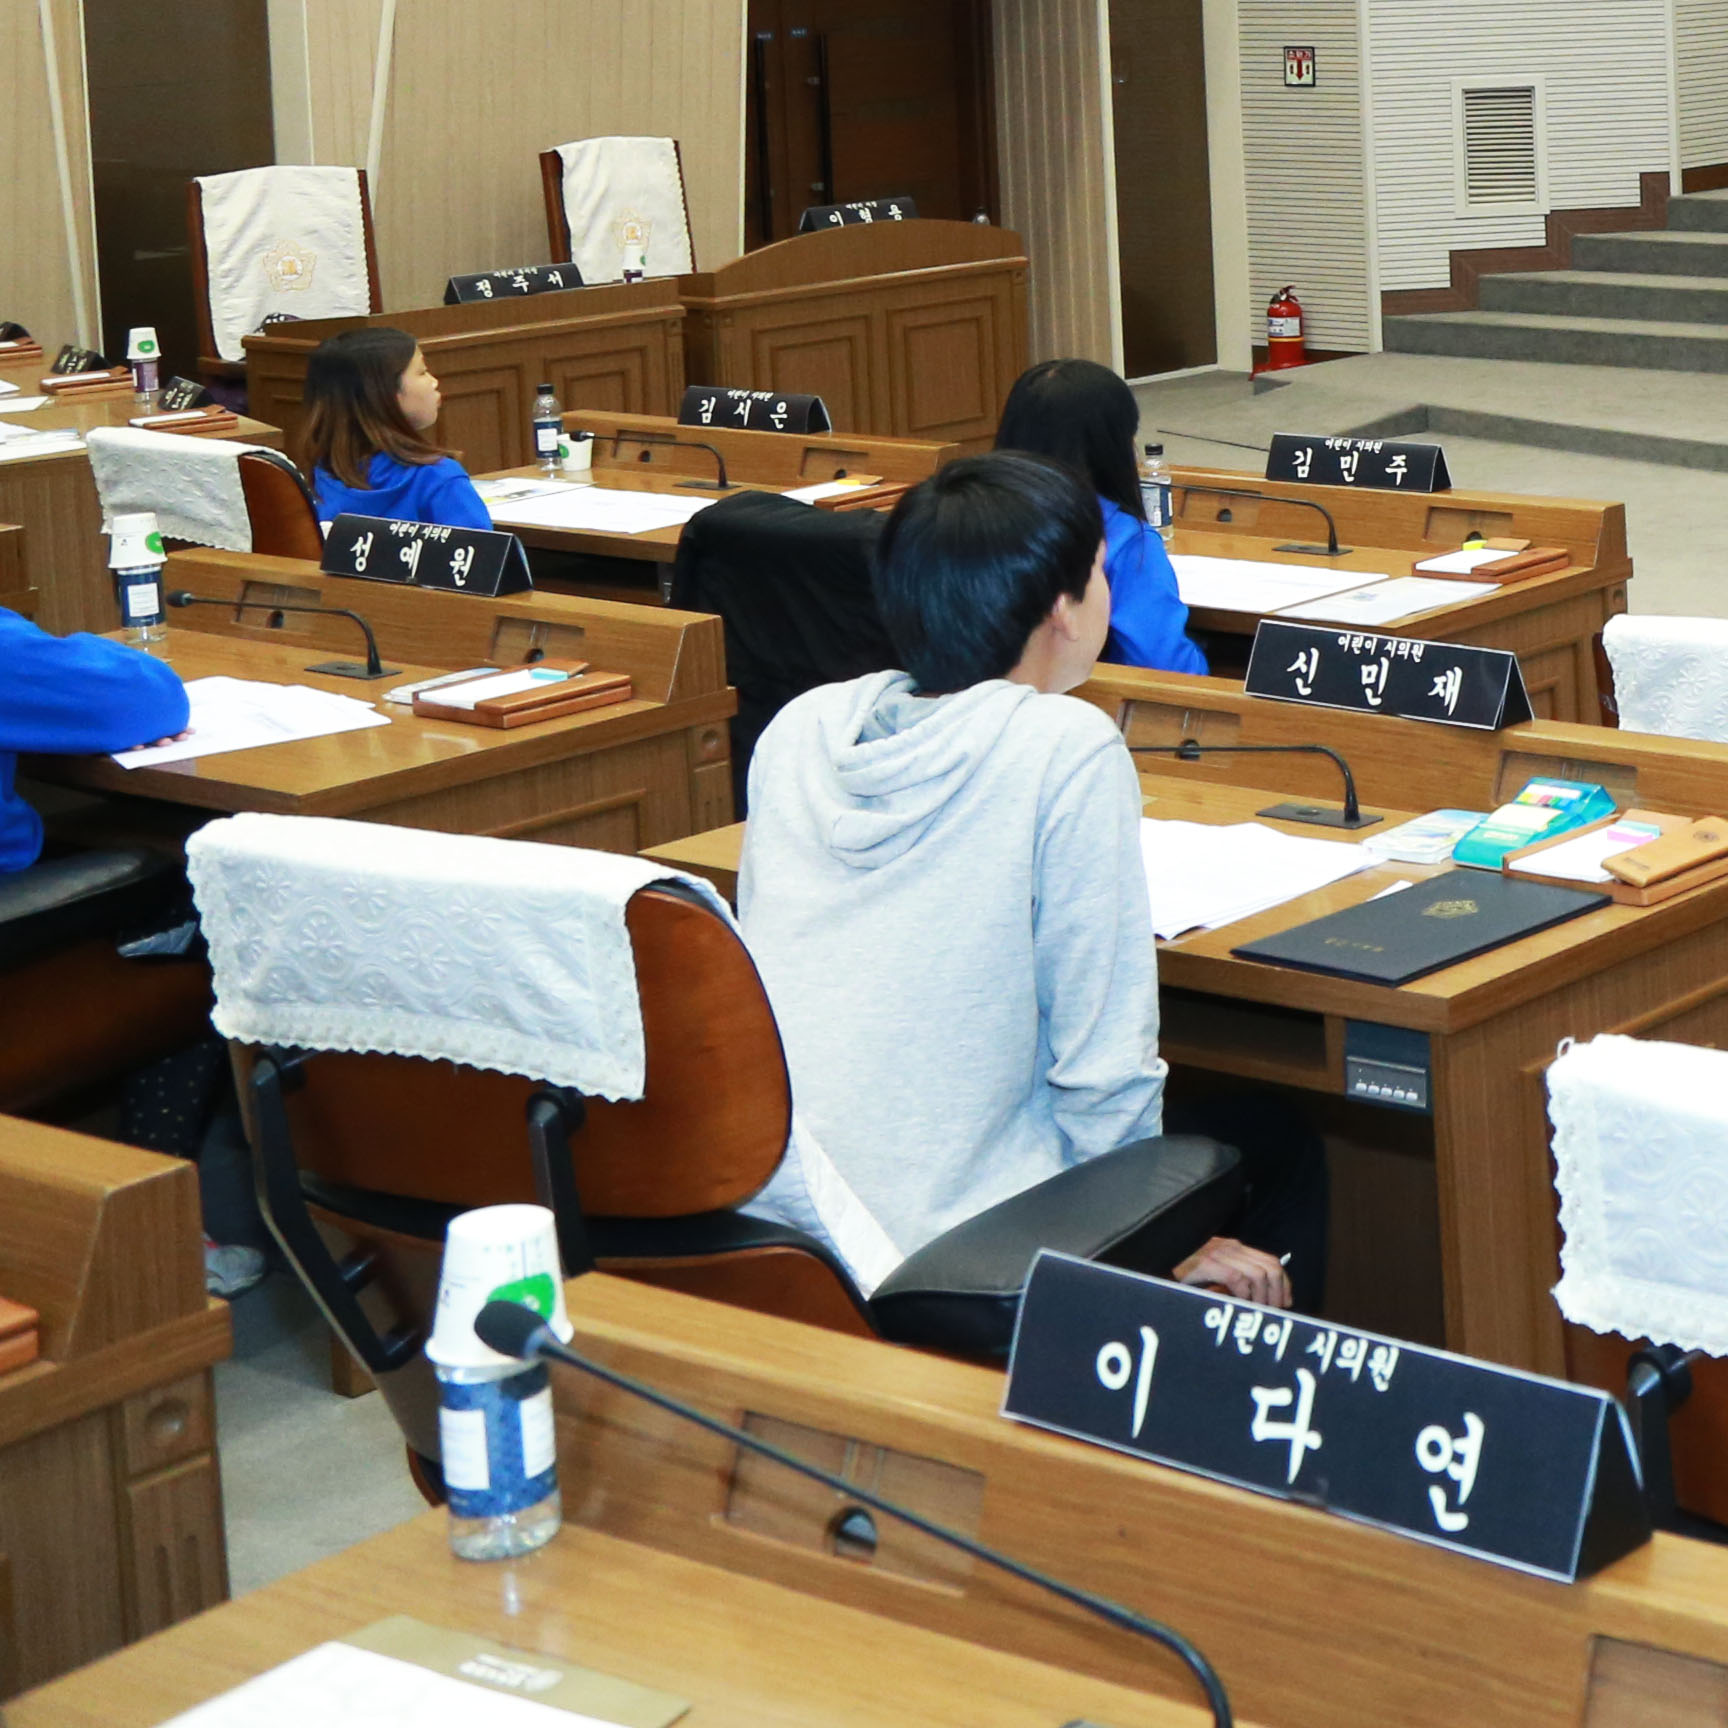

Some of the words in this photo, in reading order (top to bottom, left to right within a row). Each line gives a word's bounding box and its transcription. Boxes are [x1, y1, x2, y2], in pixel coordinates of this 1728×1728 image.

[1324, 437, 1351, 452] 어린이
[1354, 439, 1384, 454] 시의원
[389, 521, 419, 538] 어린이
[422, 524, 452, 544] 시의원
[1337, 633, 1377, 656] 어린이
[1383, 639, 1425, 663] 시의원
[1204, 1302, 1294, 1363] 어린이
[1306, 1329, 1400, 1393] 시의원
